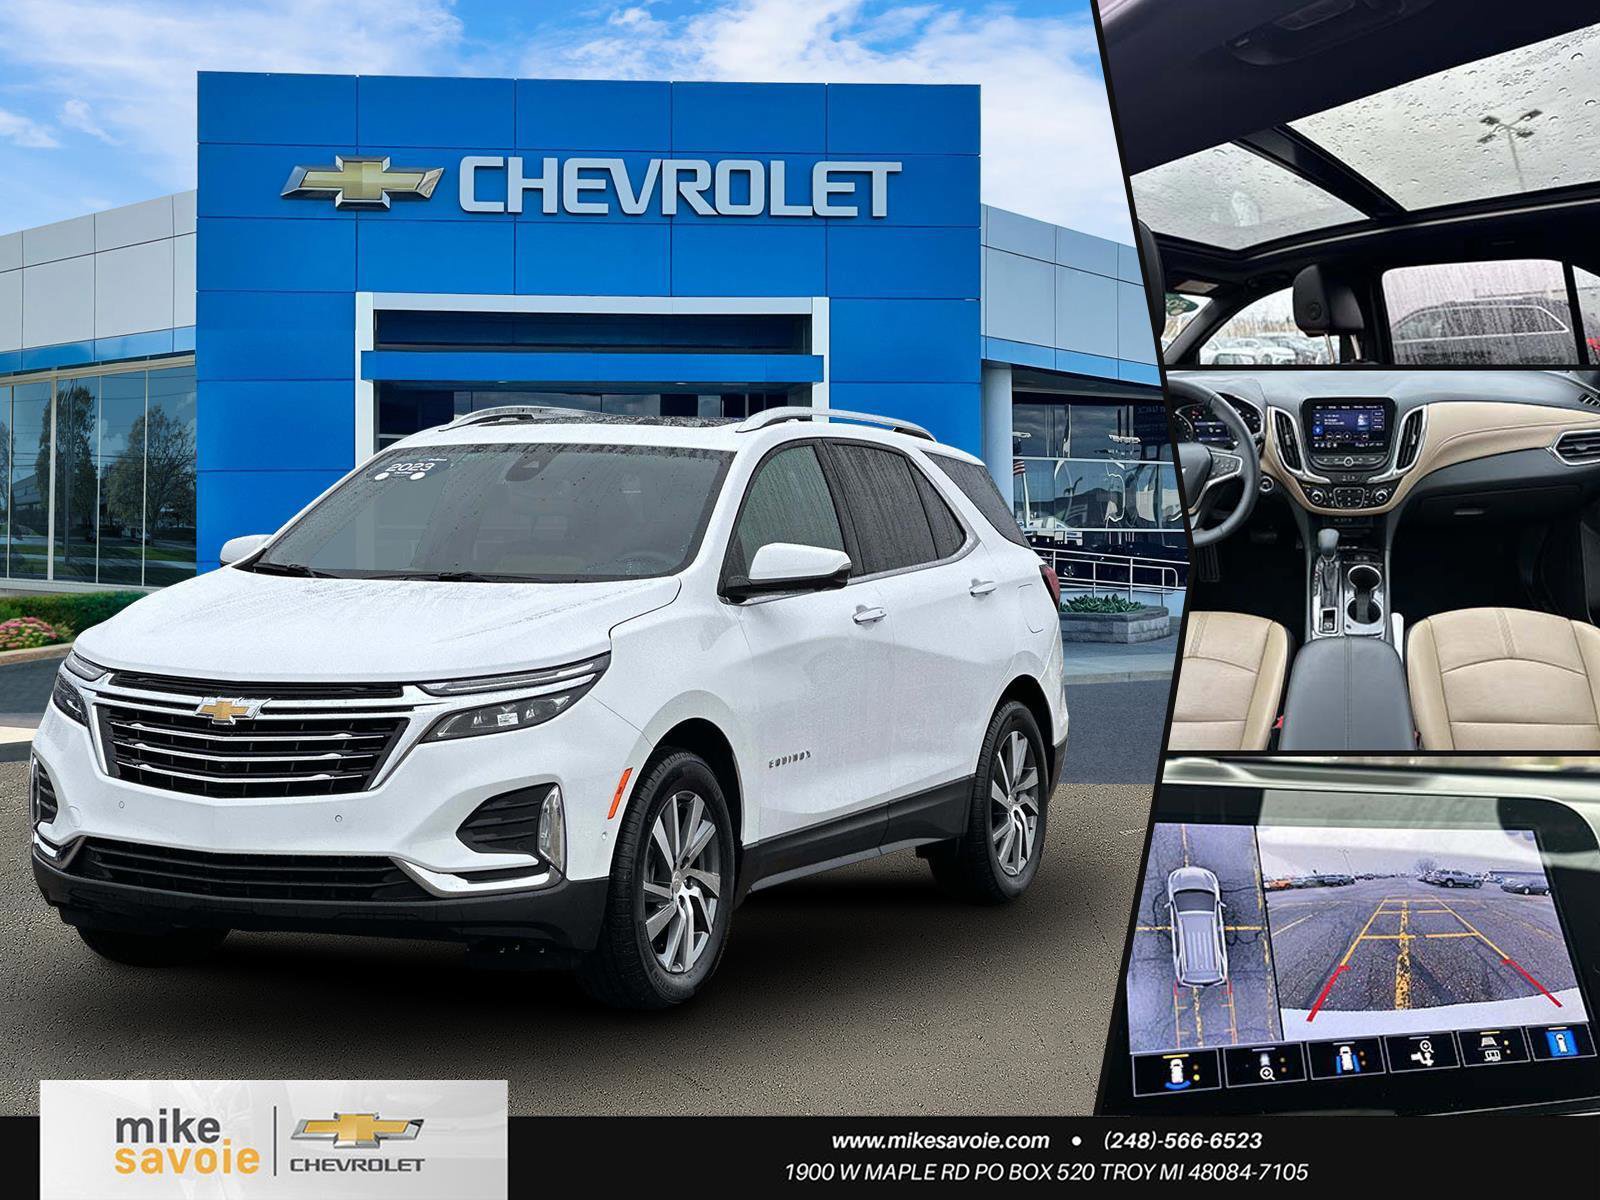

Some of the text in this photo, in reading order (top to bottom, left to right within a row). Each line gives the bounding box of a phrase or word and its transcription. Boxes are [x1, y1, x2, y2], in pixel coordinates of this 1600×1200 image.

[459, 155, 902, 218] CHEVROLET
[385, 462, 435, 472] 2023
[768, 750, 811, 769] EQUINOX
